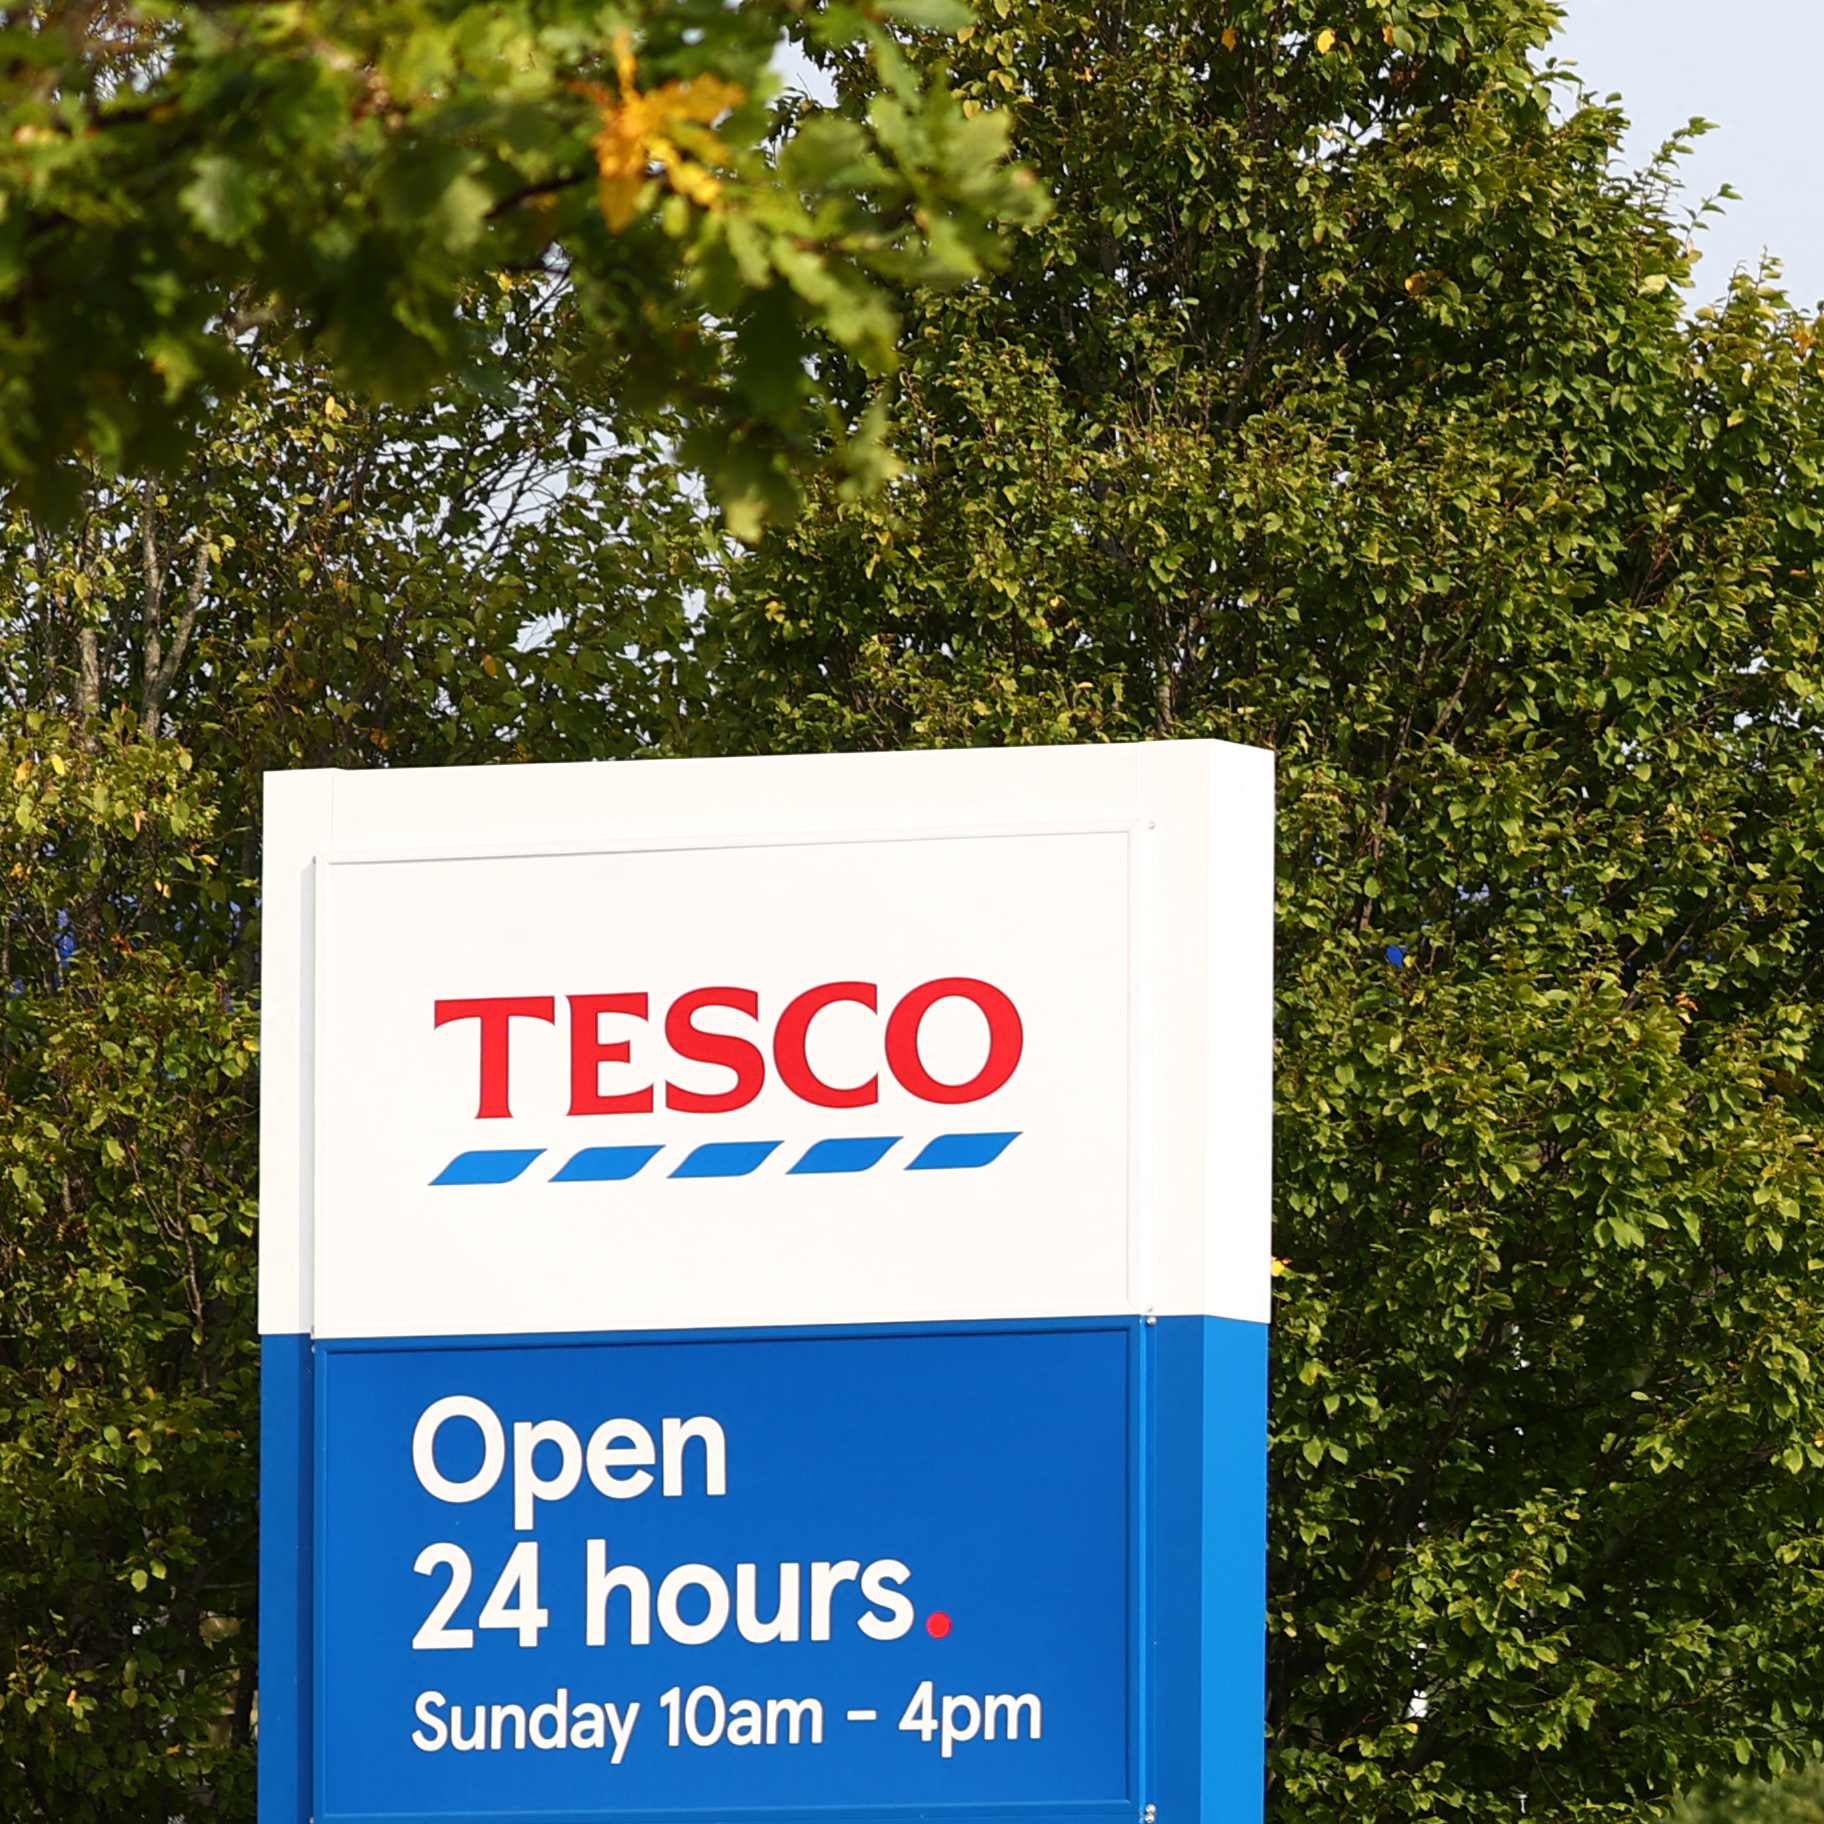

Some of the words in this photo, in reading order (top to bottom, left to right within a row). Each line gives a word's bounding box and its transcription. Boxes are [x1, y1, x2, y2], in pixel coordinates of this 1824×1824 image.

[432, 976, 1024, 1119] TESCO
[412, 1395, 727, 1530] Open
[412, 1541, 549, 1650] 24
[586, 1538, 953, 1646] hours.
[411, 1688, 641, 1765] Sunday
[659, 1684, 824, 1748] 10am
[898, 1680, 1042, 1757] 4pm
